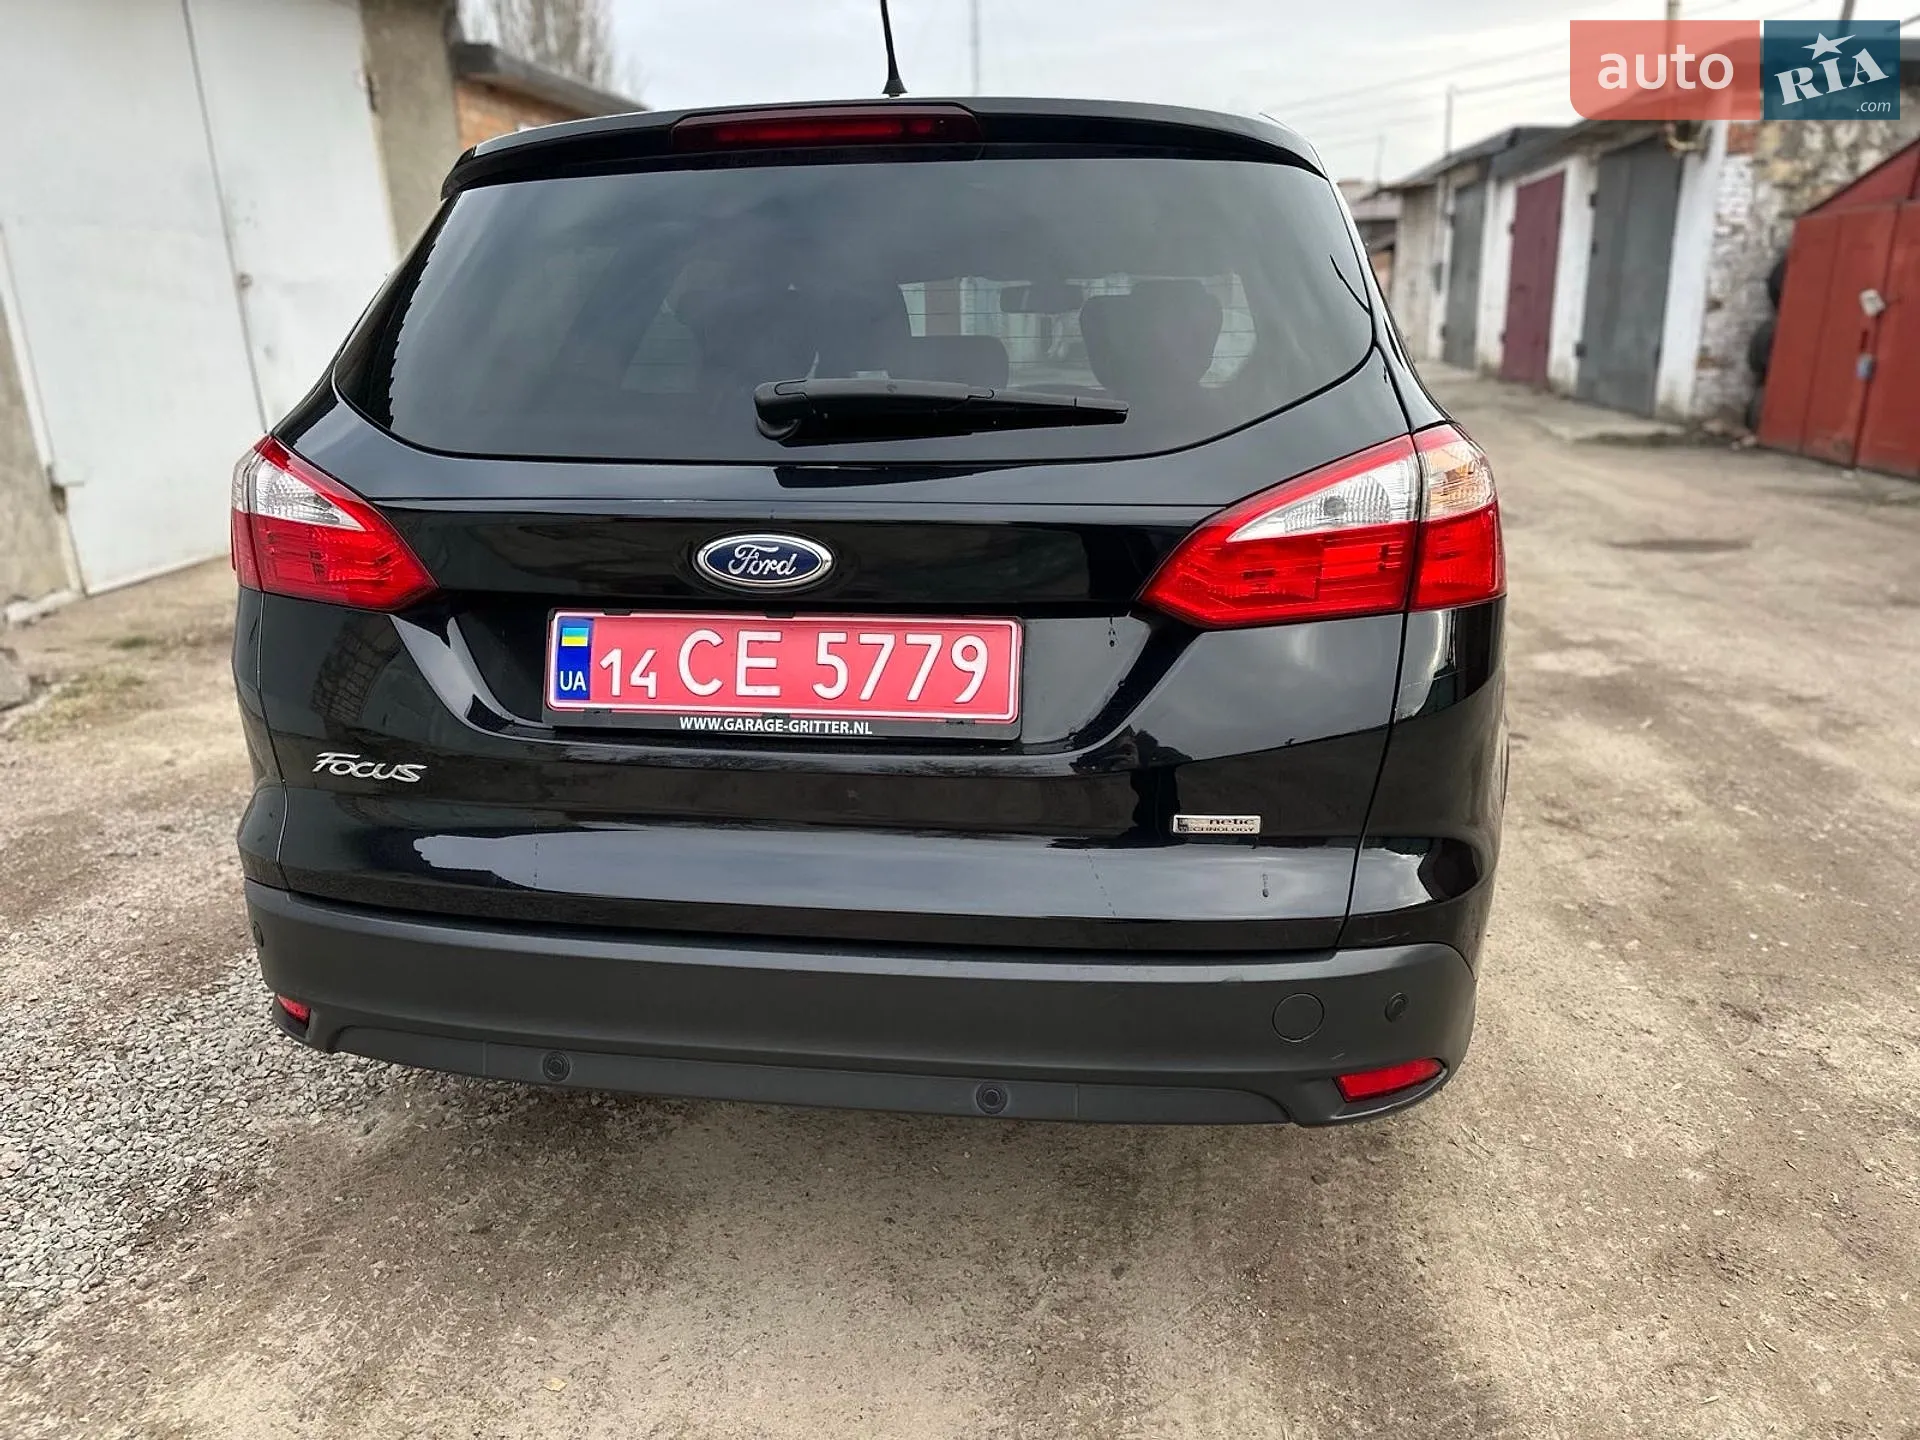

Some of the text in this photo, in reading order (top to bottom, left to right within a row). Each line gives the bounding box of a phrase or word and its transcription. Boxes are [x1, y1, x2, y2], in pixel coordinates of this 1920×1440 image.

[728, 544, 798, 575] Ford
[599, 629, 989, 704] 14 CE 5779
[560, 671, 586, 691] UA
[679, 717, 873, 736] WWW.GARAGE-GRITTER.NL
